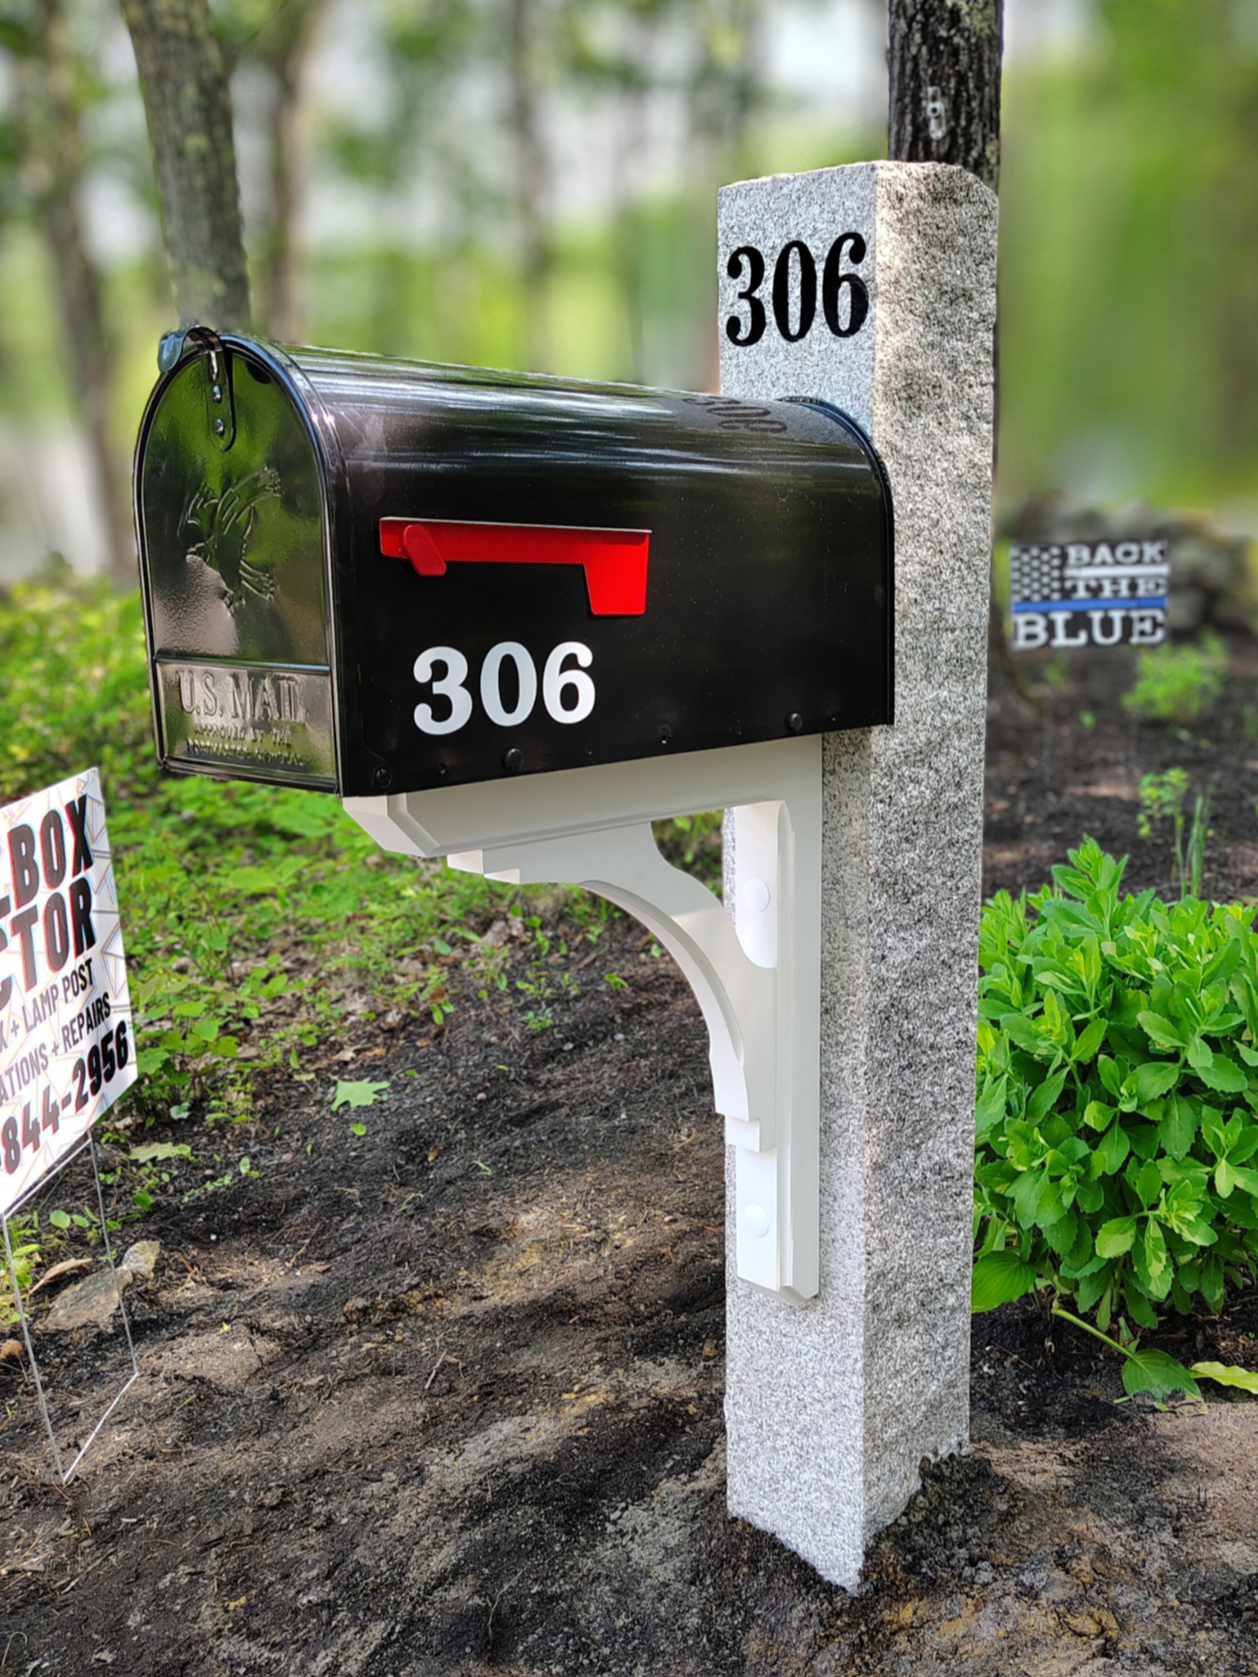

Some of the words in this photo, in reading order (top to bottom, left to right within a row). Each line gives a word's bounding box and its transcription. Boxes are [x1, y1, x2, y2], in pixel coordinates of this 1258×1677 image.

[726, 232, 869, 347] 306
[1065, 541, 1164, 566] BACK
[1063, 577, 1167, 599] THE
[1012, 608, 1166, 651] BLUE
[177, 669, 224, 718] U.S.
[229, 671, 305, 722] MAIL
[413, 641, 596, 736] 306
[22, 984, 59, 1034] LAMP
[62, 957, 94, 1004] POST
[61, 991, 111, 1054] REPAIRS
[0, 1019, 128, 1175] 844-2956
